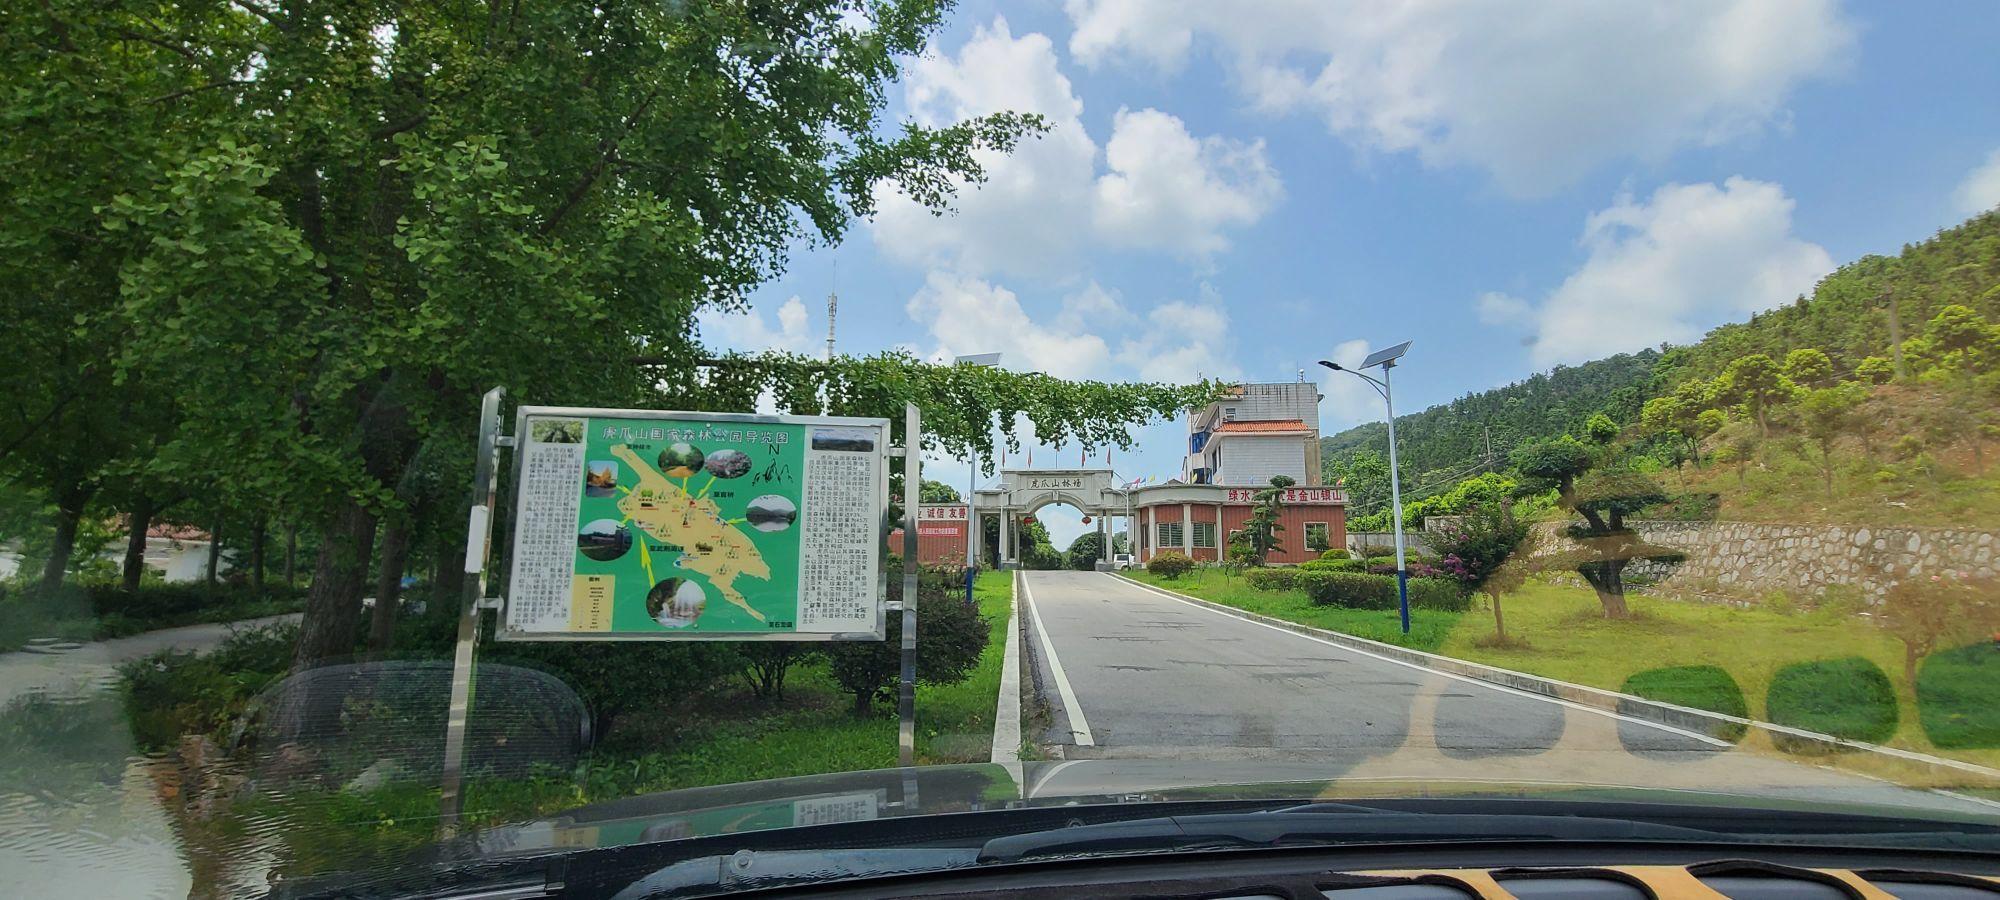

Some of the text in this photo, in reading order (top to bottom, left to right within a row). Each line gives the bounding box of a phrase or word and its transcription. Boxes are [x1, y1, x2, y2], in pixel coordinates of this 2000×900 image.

[602, 427, 789, 444] 虎爪山国家森林公园导览图
[768, 444, 780, 455] N
